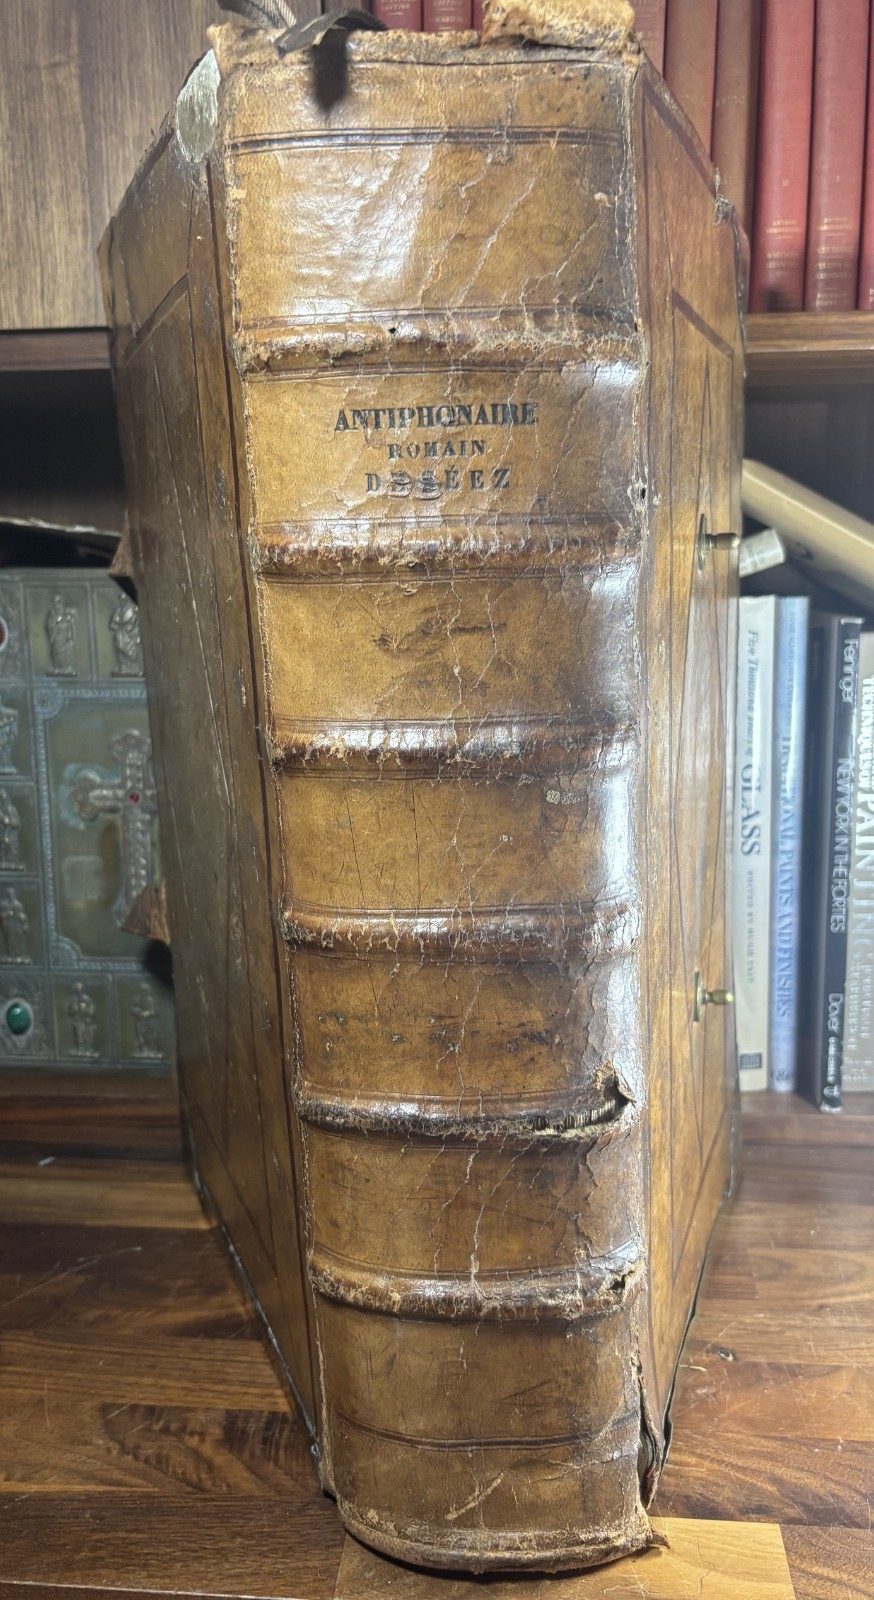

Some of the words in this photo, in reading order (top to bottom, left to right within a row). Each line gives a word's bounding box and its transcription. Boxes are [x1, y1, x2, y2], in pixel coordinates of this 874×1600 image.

[334, 402, 539, 432] ANTIPHONAIRE
[386, 440, 487, 460] ROMAIN
[836, 757, 854, 793] NEW
[740, 763, 762, 857] GLASS
[833, 791, 852, 834] YORK
[833, 835, 850, 852] IN
[778, 849, 796, 906] PAINTS
[832, 852, 849, 878] THE
[830, 878, 847, 933] FORTIES
[777, 907, 794, 945] AND
[776, 946, 793, 1018] FINISHES
[828, 992, 845, 1031] Dover
